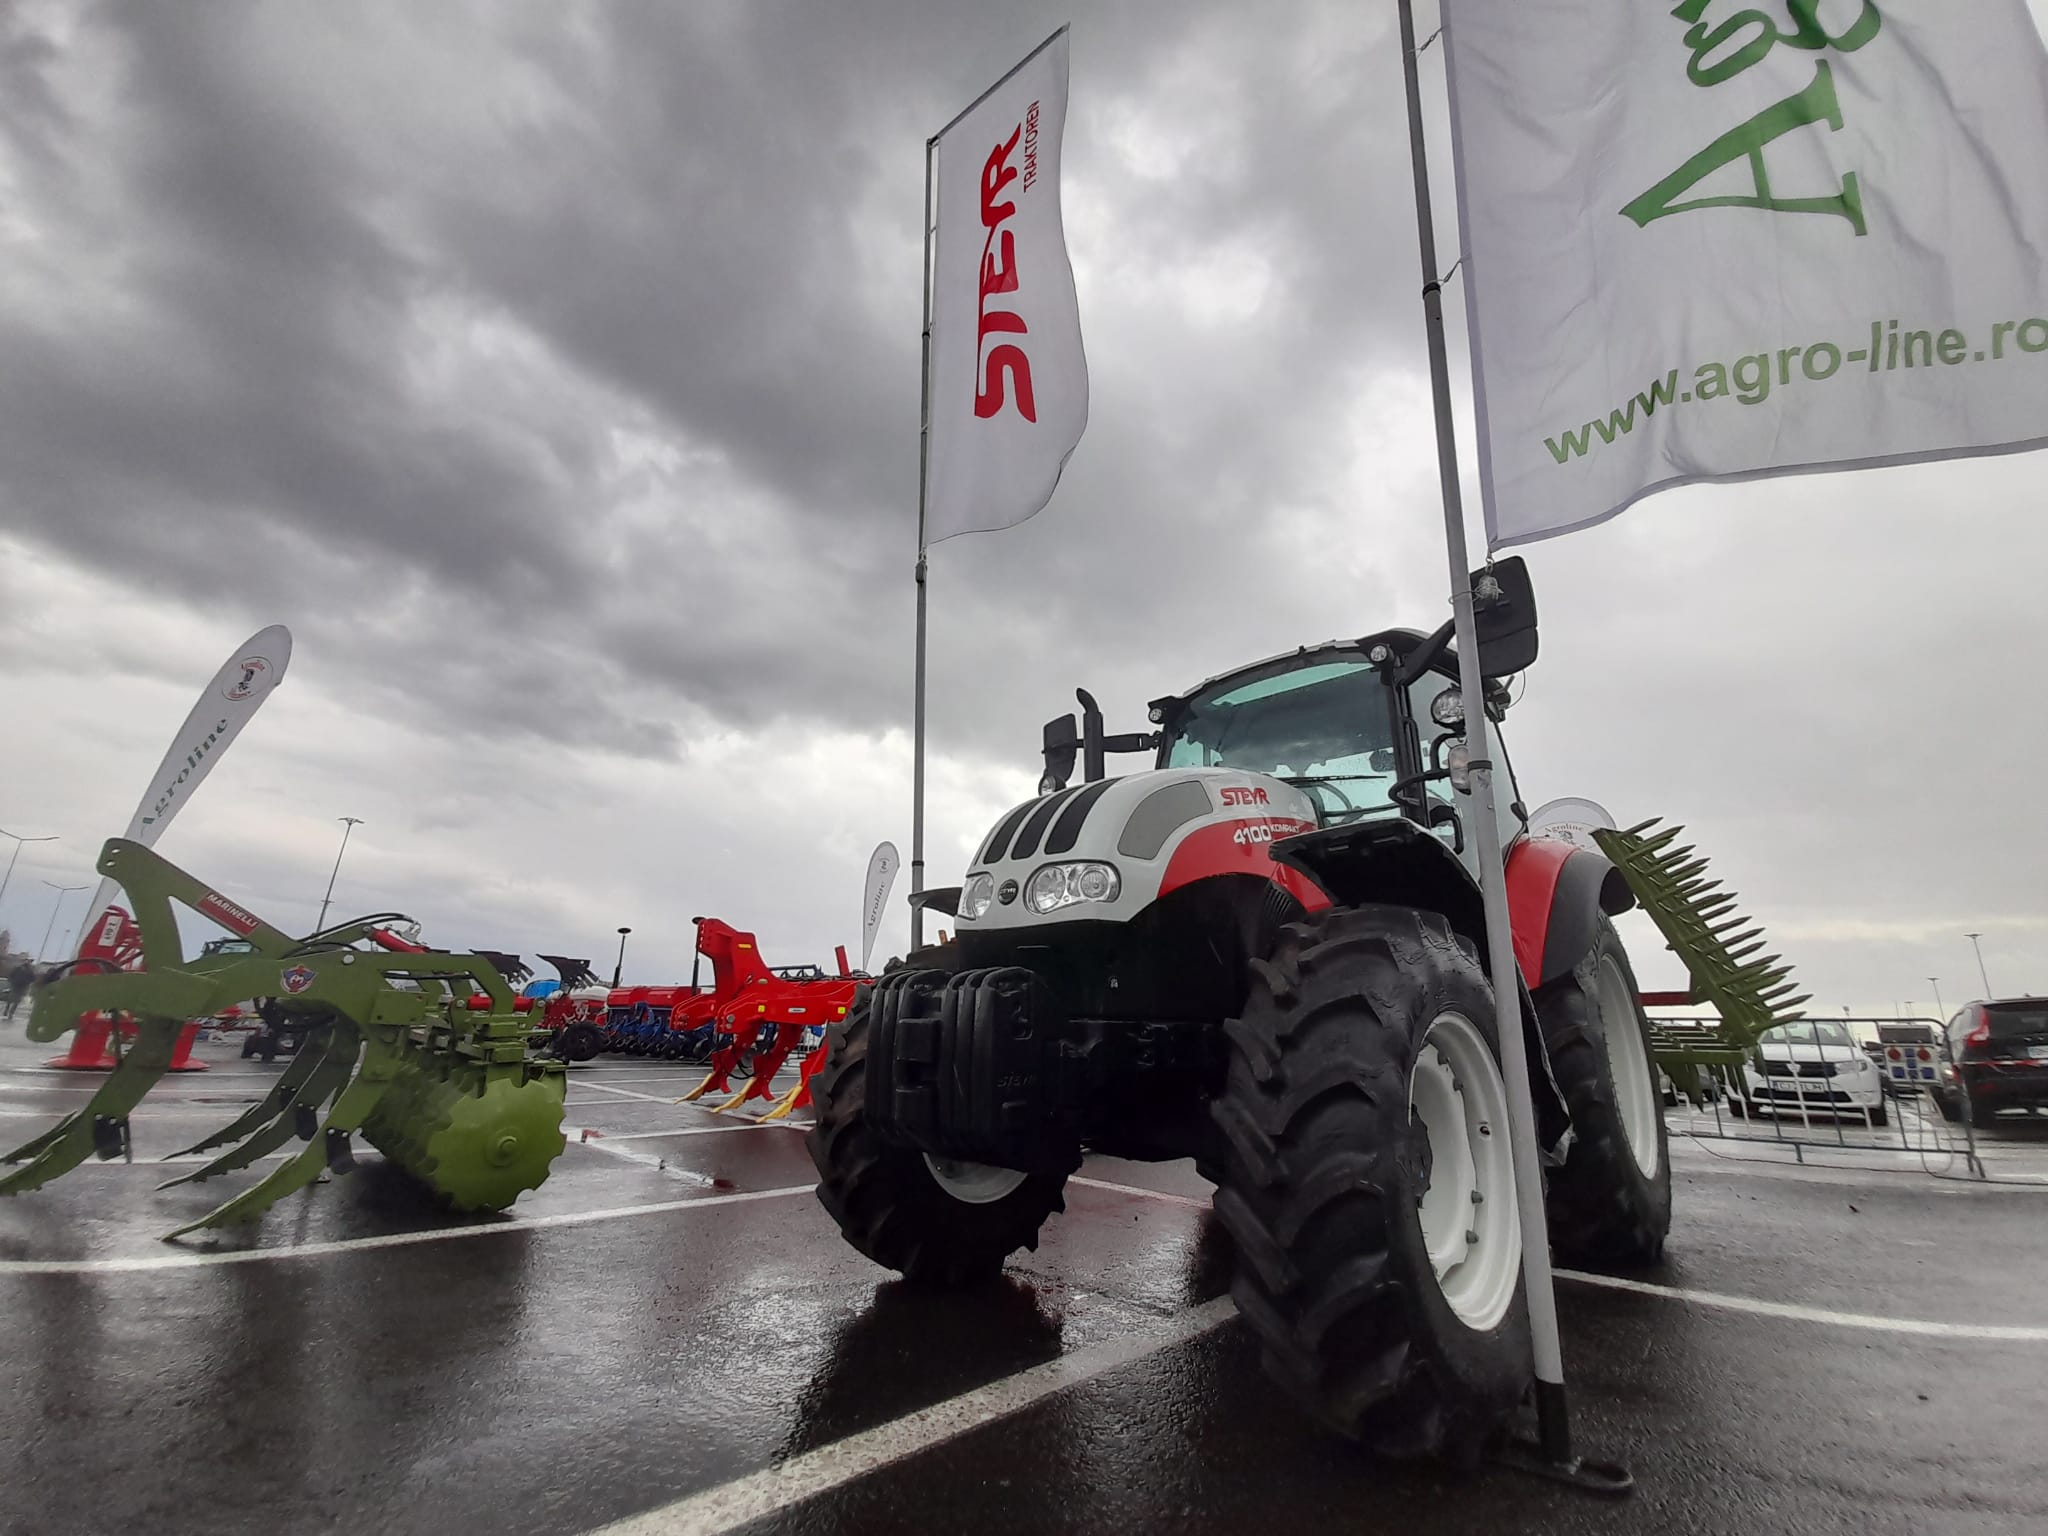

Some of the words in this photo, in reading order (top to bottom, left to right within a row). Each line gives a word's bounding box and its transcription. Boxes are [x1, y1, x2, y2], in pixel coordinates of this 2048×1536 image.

[1023, 99, 1040, 194] TRAKTOREN
[973, 121, 1037, 424] STEYR
[1543, 316, 2048, 465] www.agro-line.ro
[1220, 786, 1271, 807] STEYR
[1233, 824, 1272, 845] 4100
[206, 893, 259, 928] MARINELLI
